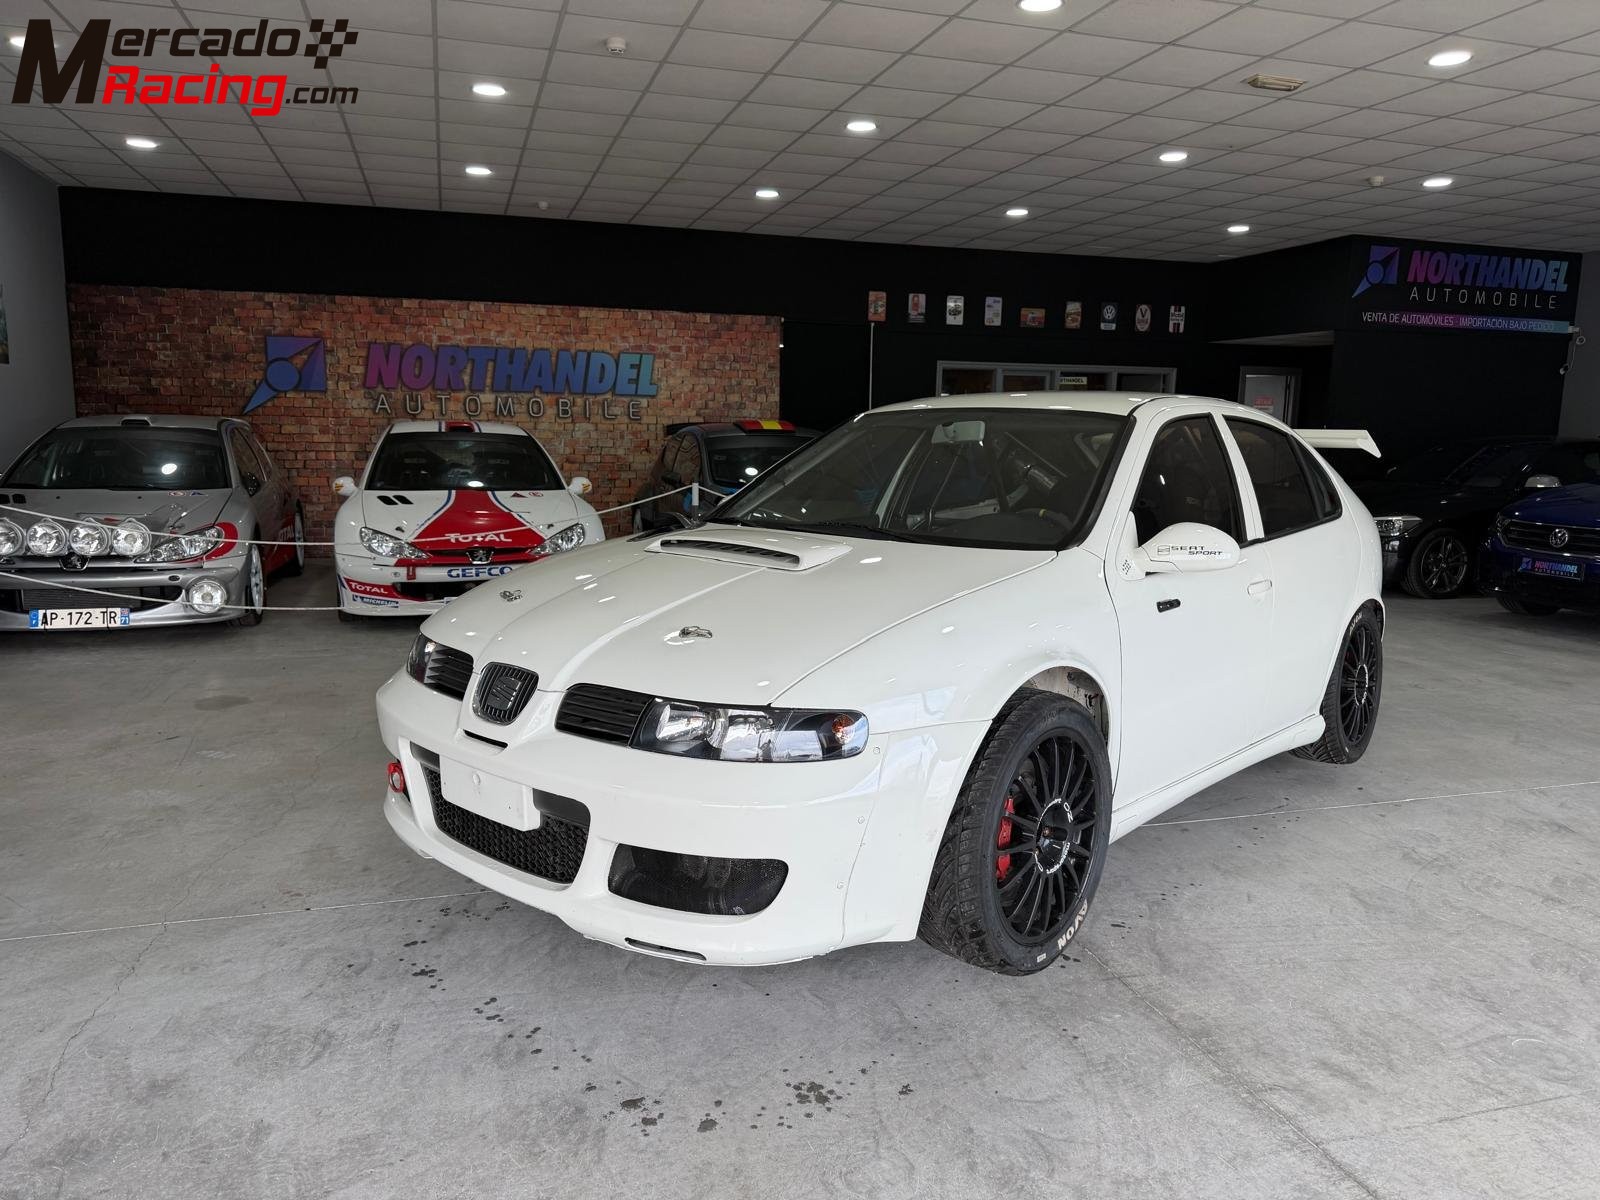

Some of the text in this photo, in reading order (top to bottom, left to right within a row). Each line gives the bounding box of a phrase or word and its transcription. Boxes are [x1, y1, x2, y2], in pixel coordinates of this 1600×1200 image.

[1407, 250, 1569, 292] NORTHANDEL
[1409, 286, 1558, 309] AUTOMOBILE
[1362, 311, 1388, 323] VENTA
[1389, 313, 1400, 324] DE
[363, 342, 659, 396] NORTHANDEL
[374, 396, 642, 420] AUTOMOBILE
[447, 532, 512, 544] TOTAL
[348, 581, 389, 594] TOTAL
[120, 616, 129, 625] 71
[1057, 899, 1088, 950] AVON
